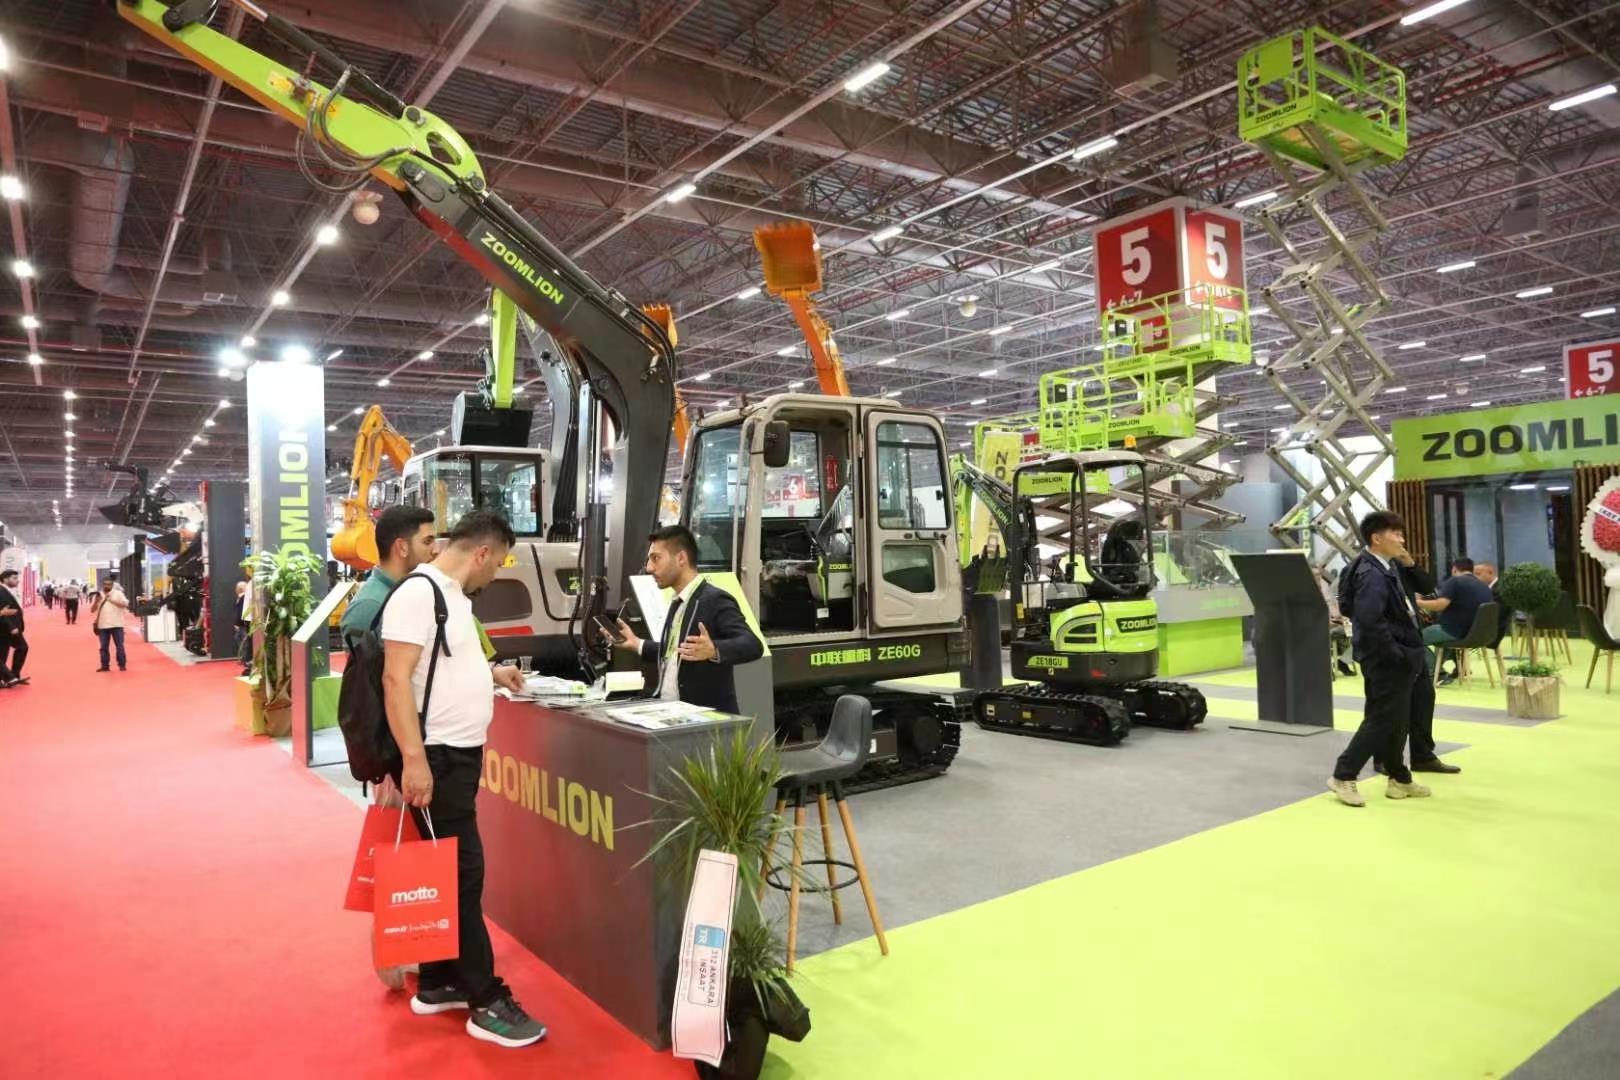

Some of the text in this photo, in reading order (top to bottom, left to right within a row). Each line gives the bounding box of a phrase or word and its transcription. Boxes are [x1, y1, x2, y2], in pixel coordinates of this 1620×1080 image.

[1255, 103, 1297, 124] ZOOMLION
[1120, 226, 1152, 286] 5
[1204, 222, 1228, 280] 5
[480, 231, 565, 305] ZOOMLION
[1588, 349, 1615, 384] 5
[1586, 385, 1607, 396] 6-7
[877, 644, 921, 660] ZE60G
[1035, 656, 1063, 667] ZE18GU
[479, 748, 614, 851] OOMLION
[391, 885, 438, 904] motto
[698, 928, 708, 944] TR
[707, 965, 716, 1004] ANKARA
